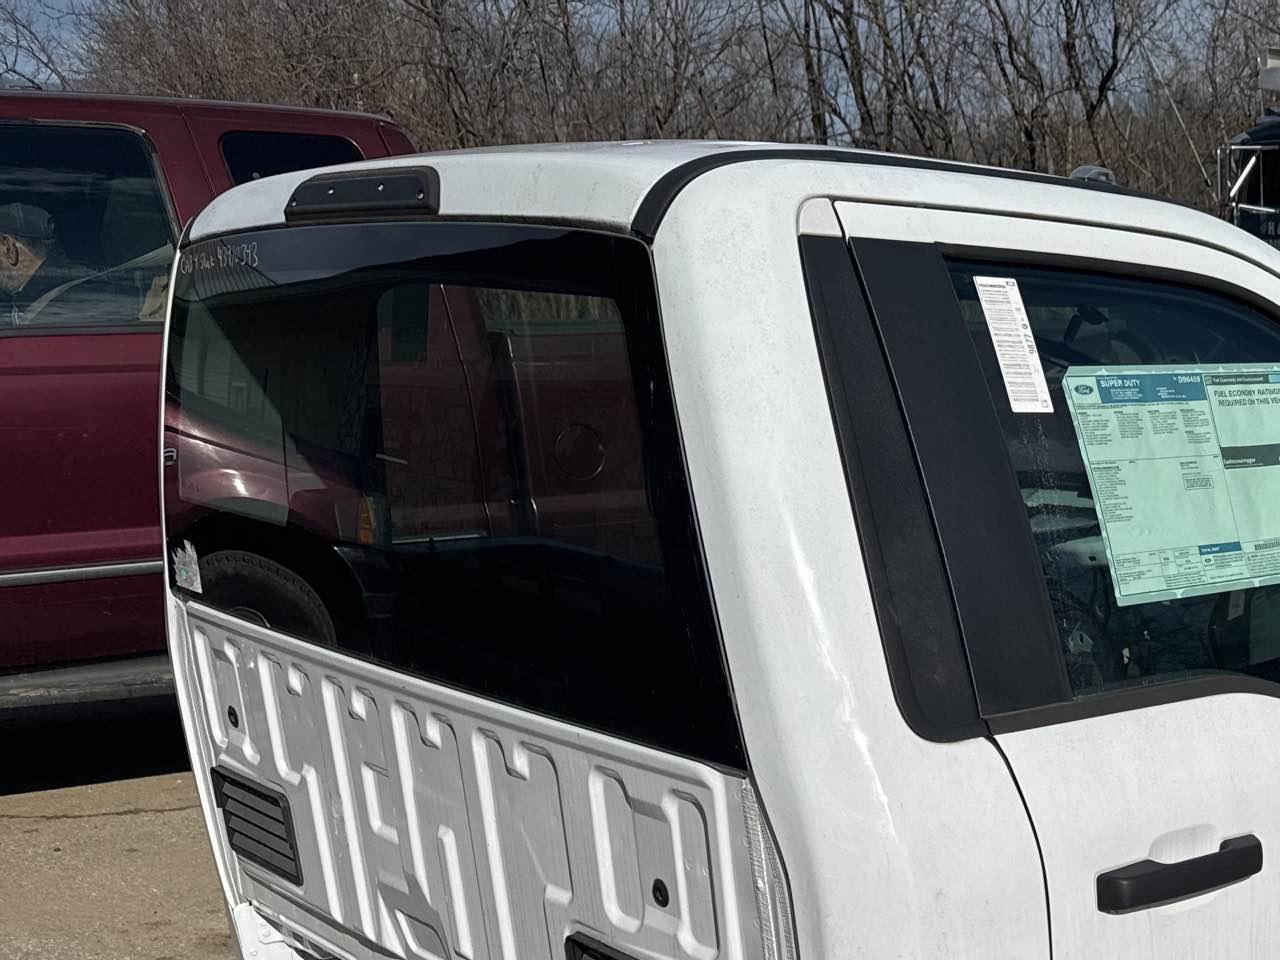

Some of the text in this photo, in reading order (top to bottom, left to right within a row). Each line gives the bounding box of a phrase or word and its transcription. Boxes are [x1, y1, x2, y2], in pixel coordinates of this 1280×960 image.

[1268, 221, 1275, 236] H
[1100, 379, 1123, 388] SUPER
[1123, 379, 1140, 387] DUTY
[1213, 390, 1228, 398] FUEL
[1229, 389, 1256, 398] ECONOMY
[1257, 388, 1280, 396] RATINGS
[1218, 398, 1247, 407] REQUIRED
[1247, 398, 1255, 406] ON
[1256, 397, 1270, 405] THIS
